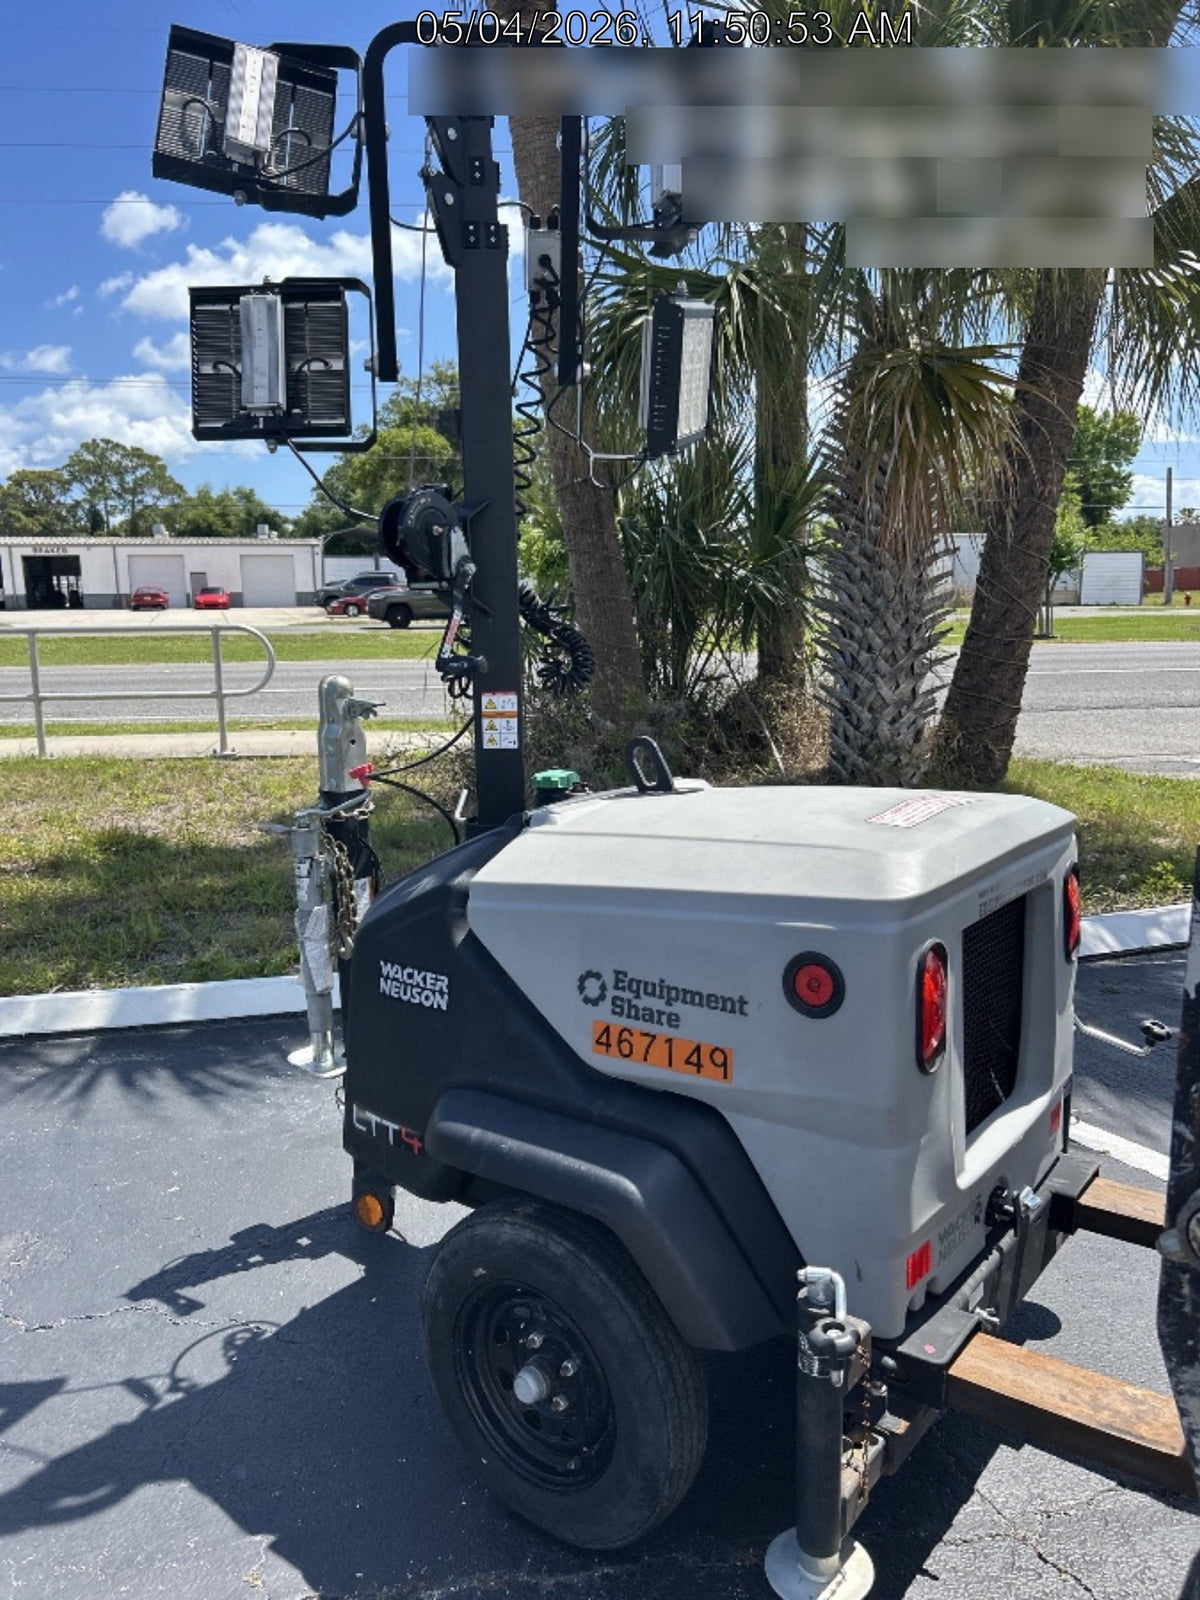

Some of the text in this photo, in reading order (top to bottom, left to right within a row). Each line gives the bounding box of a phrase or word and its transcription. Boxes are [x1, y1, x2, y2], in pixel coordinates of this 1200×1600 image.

[380, 960, 449, 993] WACKER
[613, 969, 749, 1017] Equipment
[380, 977, 448, 1011] NEUSON
[611, 995, 681, 1029] Share
[595, 1024, 729, 1080] 467149
